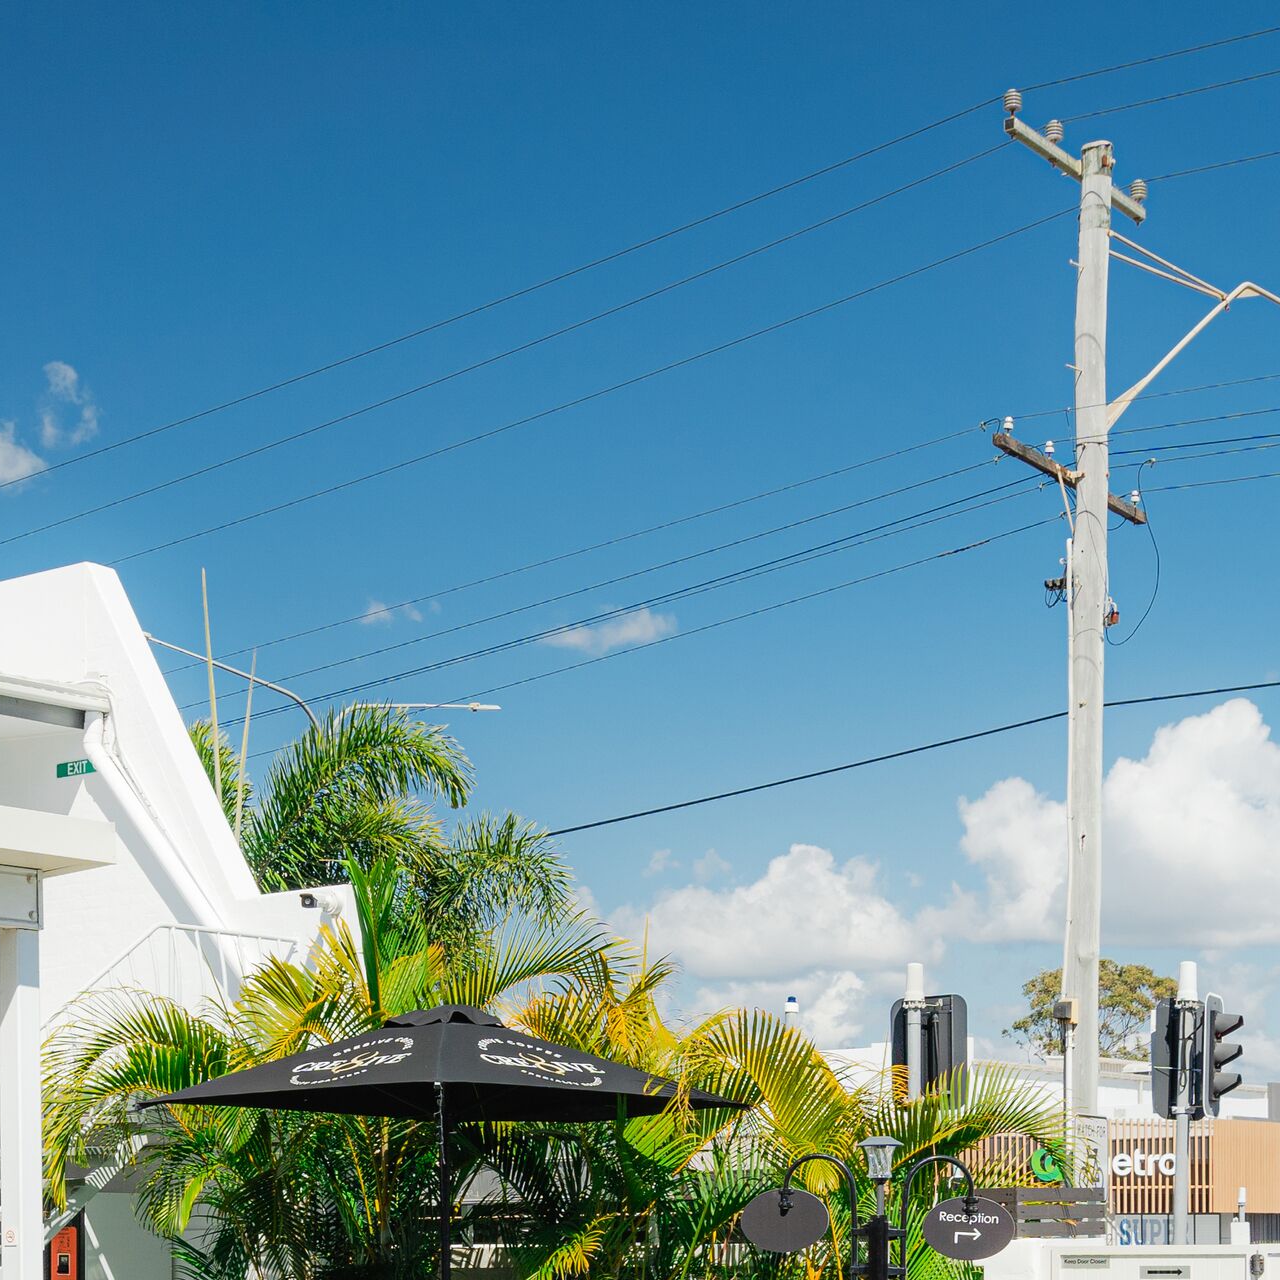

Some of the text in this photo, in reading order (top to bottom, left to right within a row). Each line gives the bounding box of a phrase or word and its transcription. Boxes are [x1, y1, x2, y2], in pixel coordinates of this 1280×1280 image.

[67, 760, 88, 776] EXIT
[1108, 1148, 1176, 1177] etro
[939, 1210, 999, 1225] Reception
